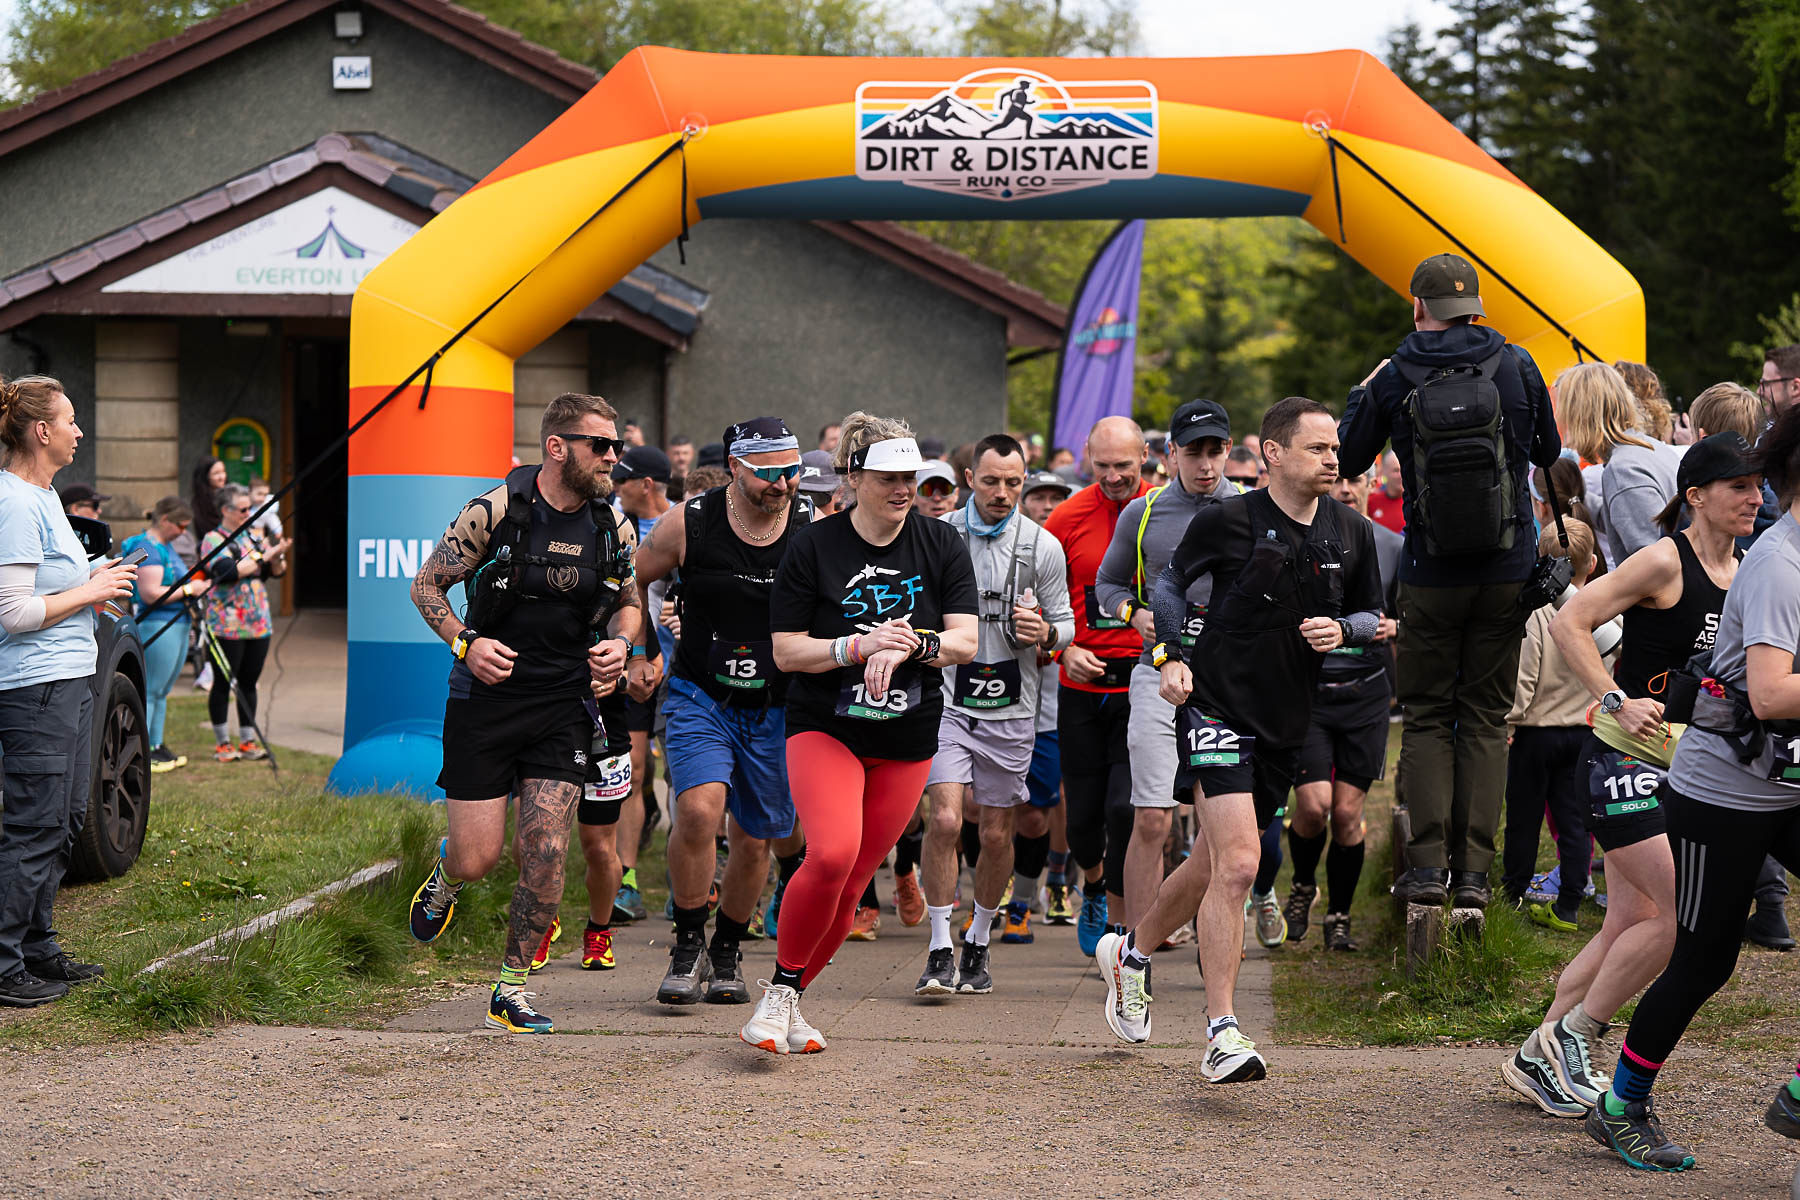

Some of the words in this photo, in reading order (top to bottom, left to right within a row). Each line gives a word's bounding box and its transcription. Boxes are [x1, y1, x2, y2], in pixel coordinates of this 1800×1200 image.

[865, 146, 939, 171] DIRT
[950, 147, 974, 171] &
[986, 145, 1149, 171] DISTANCE
[967, 176, 1009, 187] RUN
[1016, 176, 1046, 187] CO
[236, 267, 342, 285] EVERTON
[841, 575, 924, 618] SBF
[1705, 612, 1724, 632] S
[1695, 630, 1718, 644] AS
[725, 659, 757, 678] 13
[729, 679, 751, 687] SOLO
[969, 677, 1006, 697] 79
[851, 683, 908, 712] 103
[865, 710, 889, 720] SOLO
[1187, 727, 1240, 751] 122
[1199, 754, 1223, 762] SOLO
[1603, 772, 1659, 800] 116
[1621, 801, 1649, 811] SOLO
[1112, 964, 1124, 1018] TERREX
